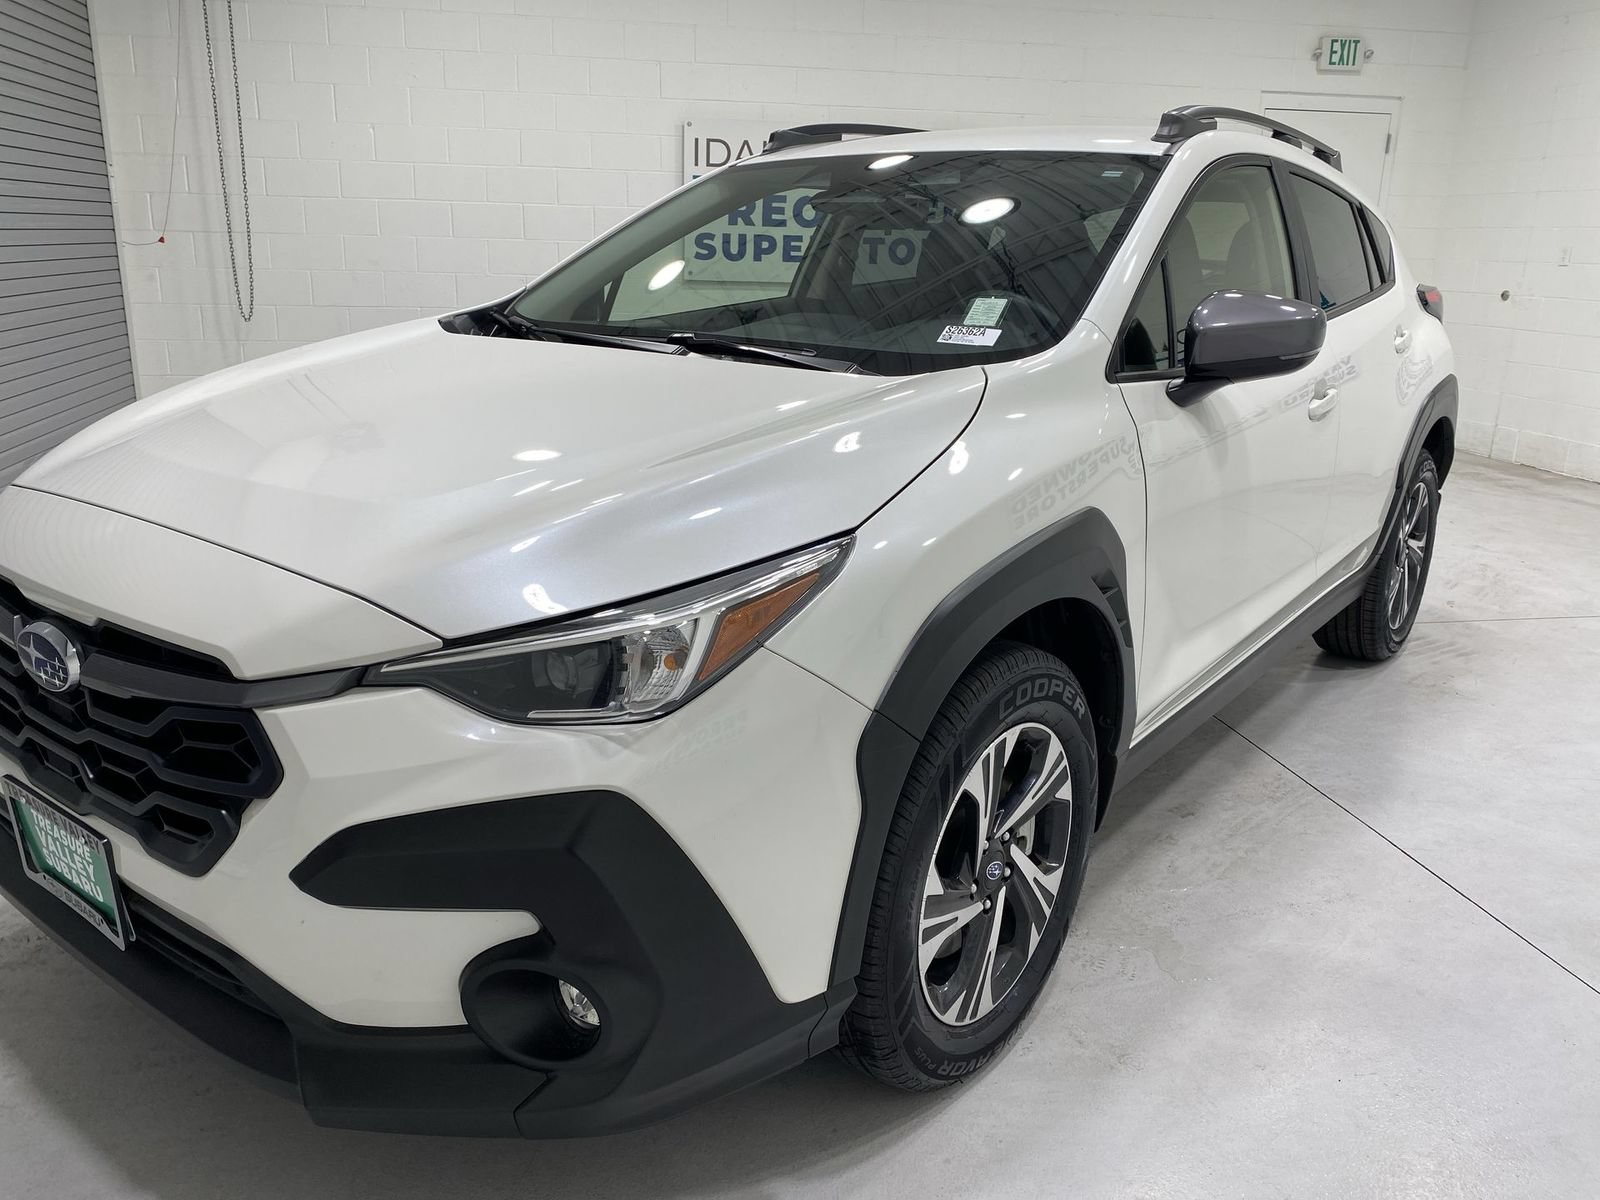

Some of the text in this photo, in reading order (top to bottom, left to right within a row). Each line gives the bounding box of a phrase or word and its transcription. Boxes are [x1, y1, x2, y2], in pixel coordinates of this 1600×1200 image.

[1328, 38, 1361, 66] EXIT
[694, 137, 767, 167] IDA
[727, 194, 824, 228] REO
[999, 678, 1086, 720] COOPER
[30, 808, 93, 863] TREASURE
[35, 825, 95, 882] VALLEY
[44, 848, 104, 903] SUBARU
[64, 890, 102, 927] SUBARU
